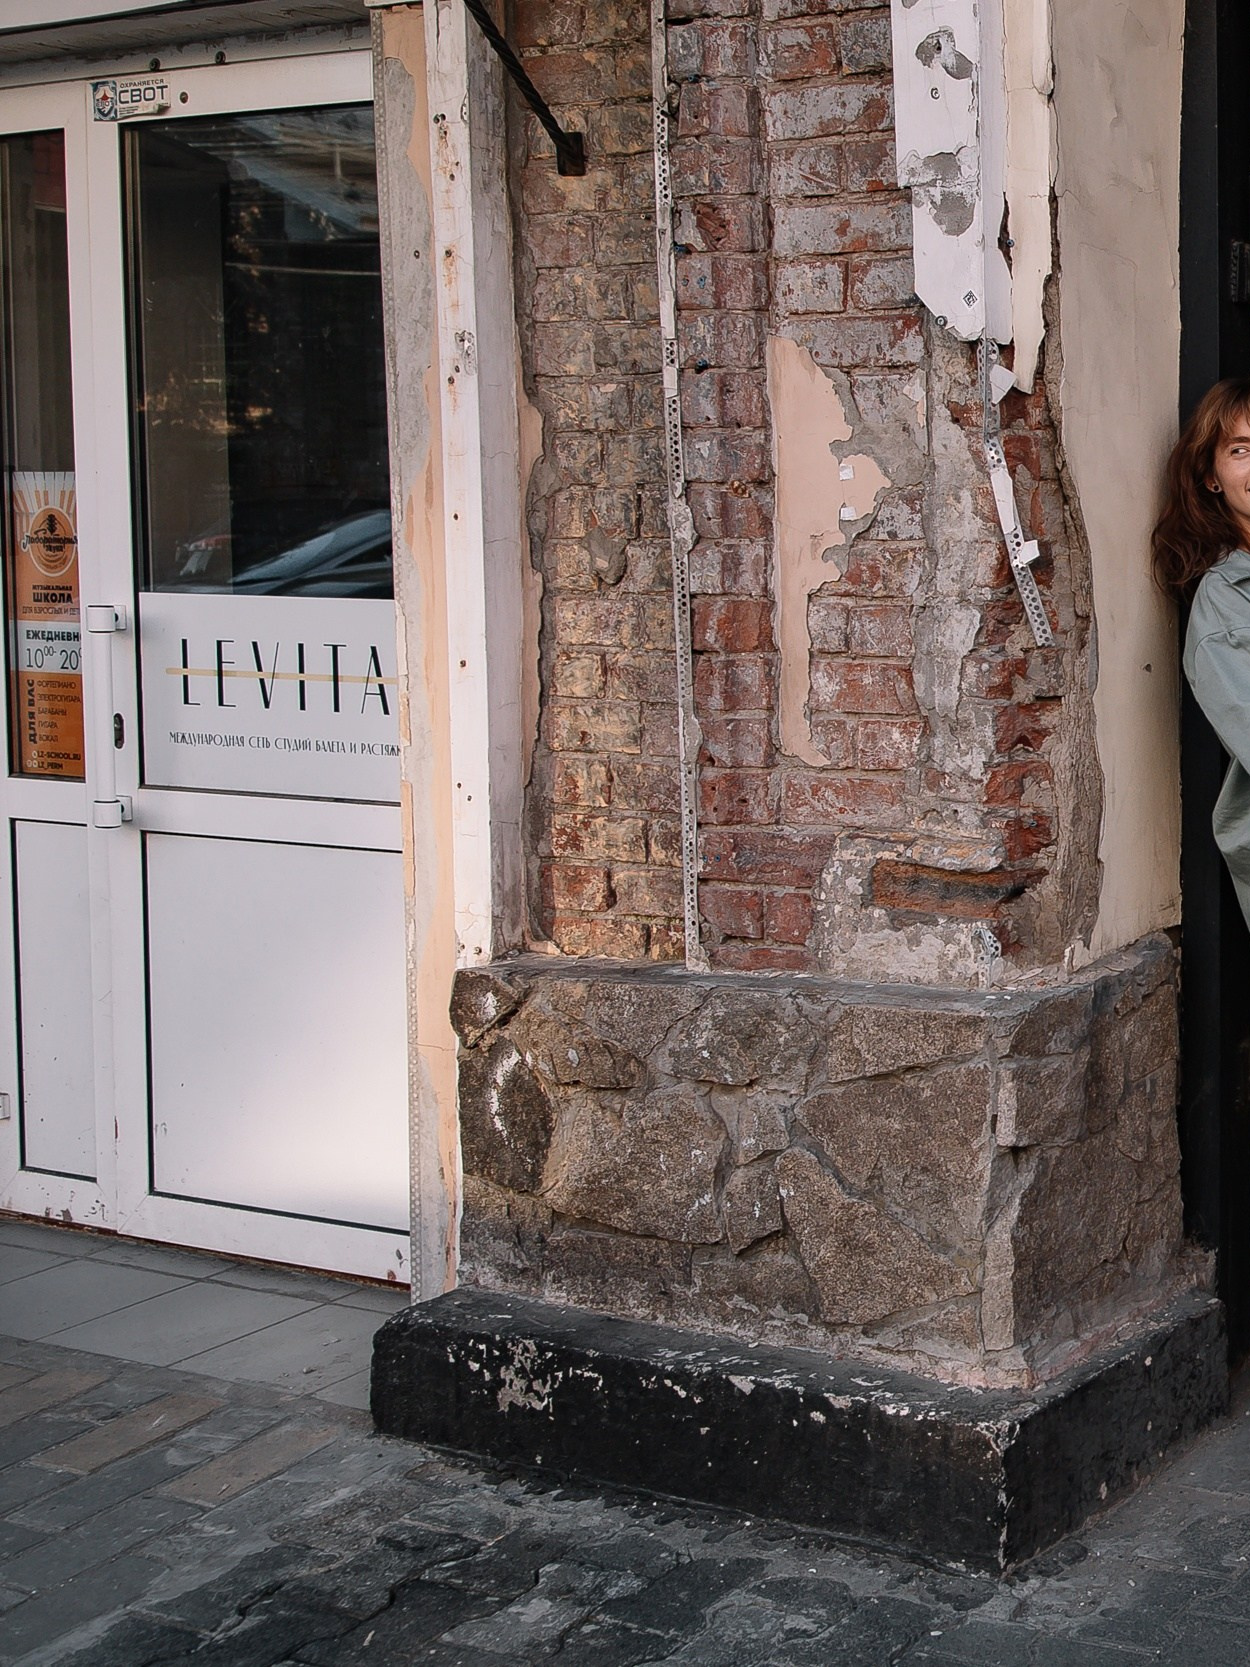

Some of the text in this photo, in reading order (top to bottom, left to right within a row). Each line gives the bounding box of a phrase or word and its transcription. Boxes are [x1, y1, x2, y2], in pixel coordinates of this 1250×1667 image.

[120, 79, 164, 88] ОХРАНЯЕТСЯ
[119, 85, 168, 104] СВОТ
[33, 593, 73, 604] ШКОЛА
[26, 630, 82, 643] ЕЖЕДНЕВН
[181, 638, 390, 715] LEVITA
[37, 680, 76, 689] ФОРТЕПИАНО
[29, 711, 37, 745] ДЛЯ
[38, 721, 58, 729] ГИТАРА
[38, 734, 58, 743] ВОКАЛ
[169, 731, 245, 747] МЕЖДУНАРОДНАЯ
[249, 736, 271, 749] СЕТЬ
[274, 737, 312, 752] СТУДИЙ
[315, 740, 346, 754] БАЛЕТА
[350, 741, 357, 754] И
